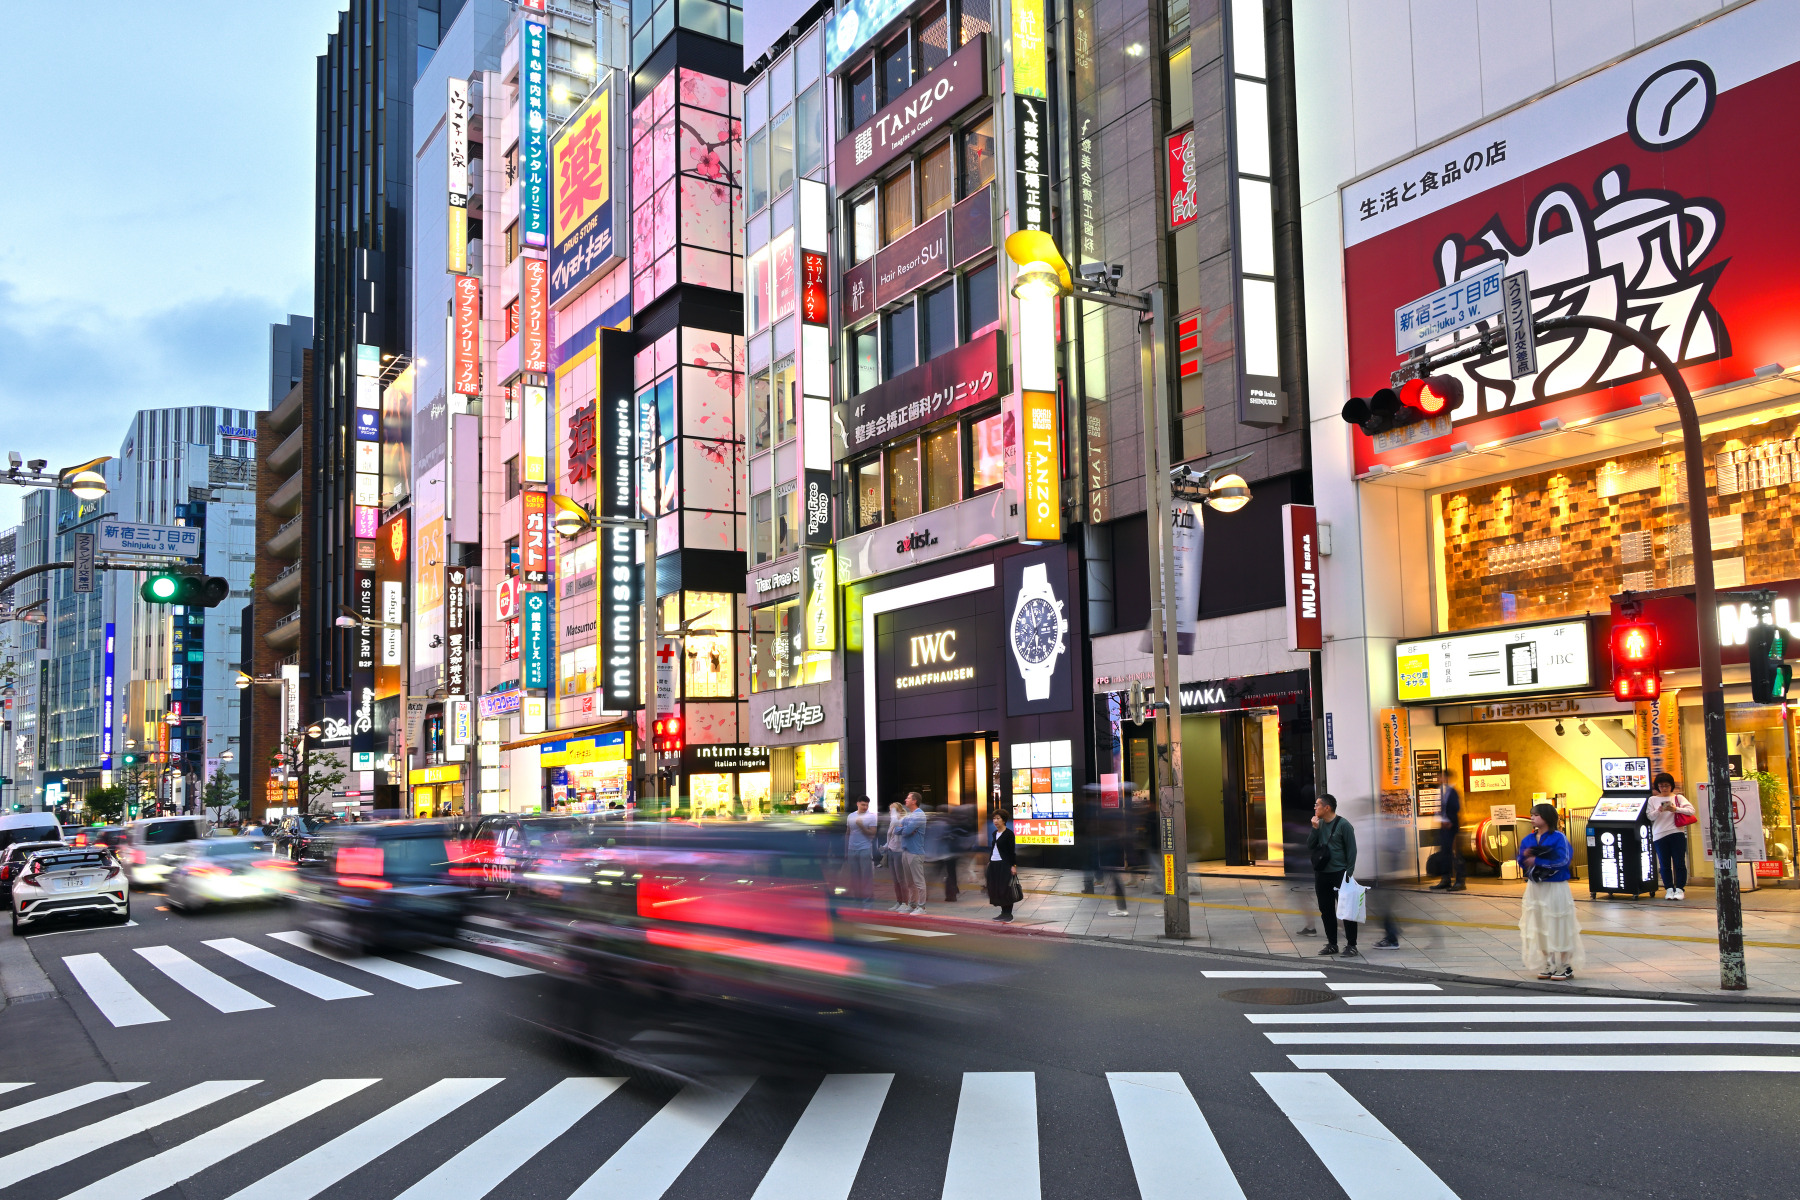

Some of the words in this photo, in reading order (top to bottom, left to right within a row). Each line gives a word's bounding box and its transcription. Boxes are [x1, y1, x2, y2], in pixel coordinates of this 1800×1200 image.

[875, 77, 954, 148] TANZO.
[559, 110, 603, 232] 薬
[1359, 139, 1508, 222] 生活と食品の店
[449, 193, 467, 207] 8F
[563, 231, 579, 254] DRUG
[579, 214, 599, 241] STORE
[880, 270, 896, 286] Hair
[897, 255, 921, 276] Resort
[920, 238, 944, 266] SUI
[529, 276, 543, 361] ブランクリニック
[1399, 272, 1500, 333] 新宿三丁目西
[1418, 317, 1456, 339] Shinjuku
[1458, 311, 1466, 322] 3
[1468, 304, 1481, 318] W.
[460, 293, 474, 383] ブランクリニック
[1508, 278, 1530, 374] スクランブル交差点
[526, 359, 546, 371] 7.8F
[456, 382, 478, 393] 7.8F
[854, 370, 993, 445] 整美会矯正歯科クリニック
[1249, 397, 1278, 406] SHINJUKU
[616, 398, 631, 456] lingerie
[854, 403, 866, 418] 4F
[525, 494, 545, 504] Café
[616, 459, 630, 506] Italian
[808, 482, 818, 513] Free
[1034, 435, 1052, 523] TANZO.
[808, 513, 818, 536] Tax
[818, 492, 829, 524] Shop
[104, 525, 196, 544] 新宿三丁目西
[121, 540, 156, 551] Shinjuku
[167, 543, 178, 552] W.
[527, 512, 544, 566] ガスト
[527, 571, 544, 582] 4F
[755, 575, 772, 594] Tax
[772, 570, 791, 589] Free
[1301, 572, 1317, 618] MUJI
[449, 586, 457, 628] COFFEE
[388, 617, 397, 657] Onitsua
[910, 629, 956, 668] IWC
[449, 633, 462, 687] 星乃珈琲店
[896, 667, 974, 689] SCHAFFHAUSEN
[1095, 676, 1109, 685] FPG
